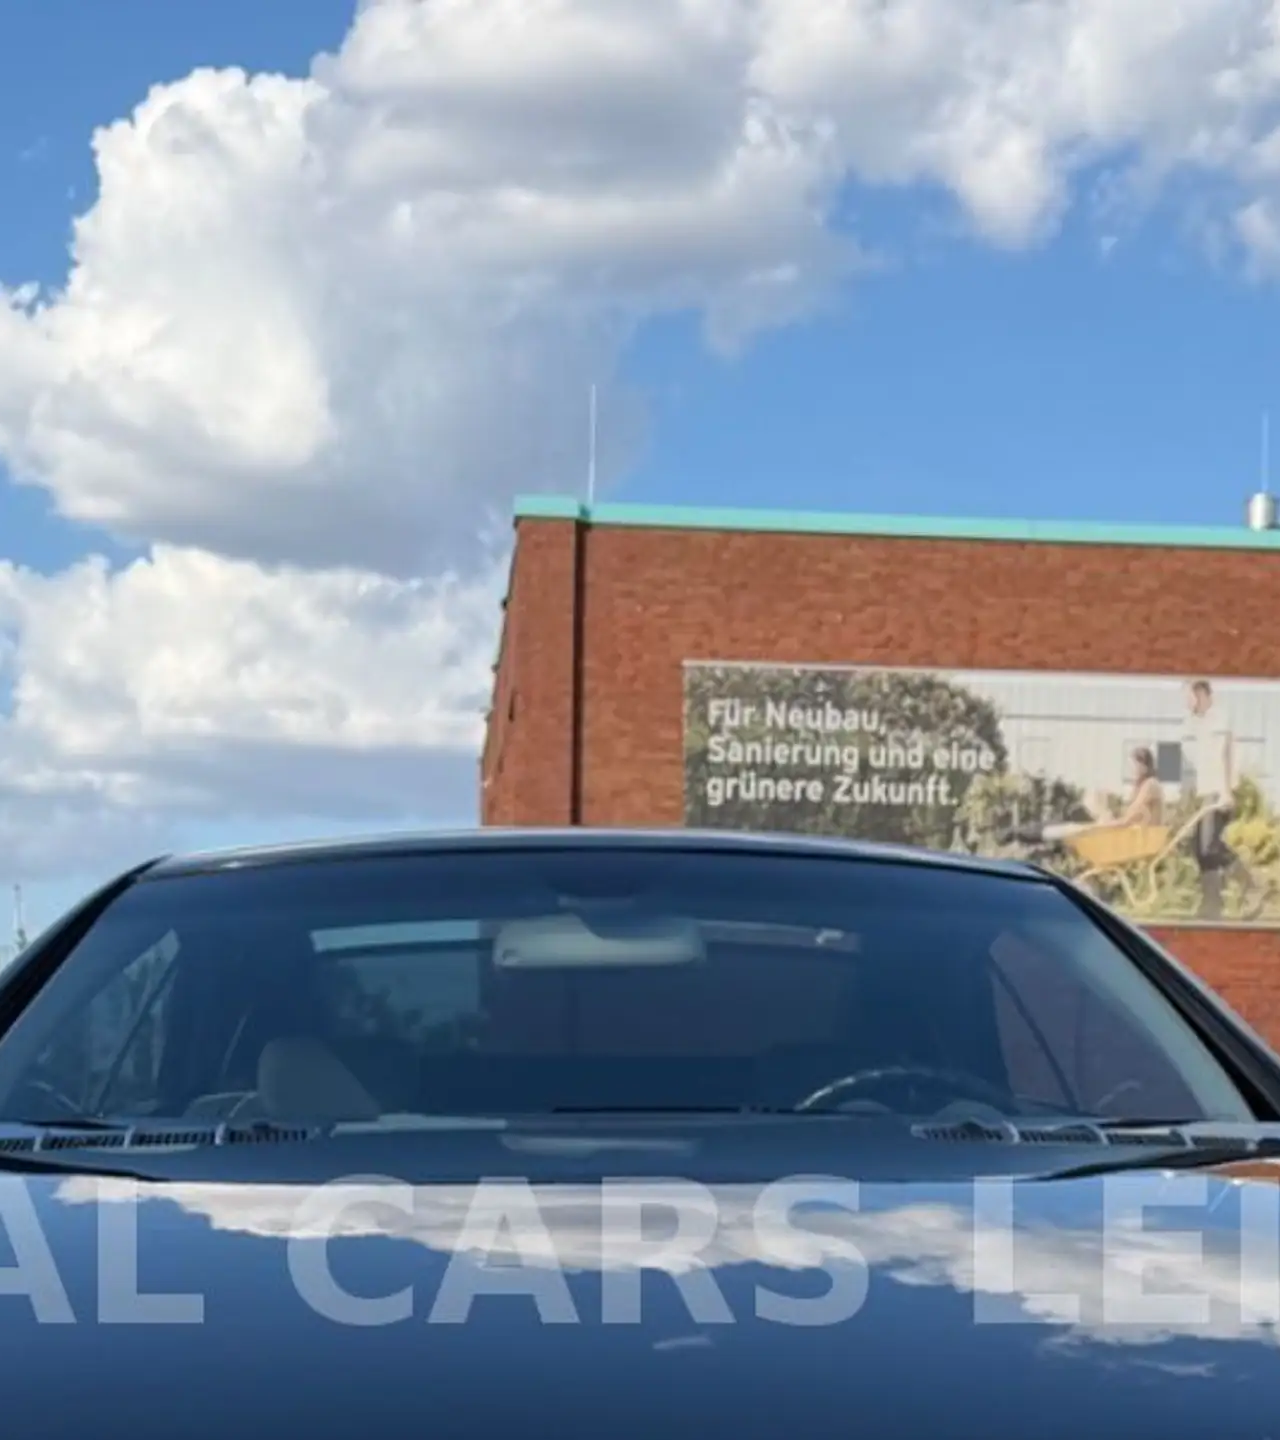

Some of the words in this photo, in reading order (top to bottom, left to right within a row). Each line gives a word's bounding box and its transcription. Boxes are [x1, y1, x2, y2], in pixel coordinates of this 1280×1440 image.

[707, 698, 756, 727] Für
[765, 702, 888, 734] Neubau,
[707, 735, 859, 773] Sanierung
[869, 741, 924, 769] und
[932, 743, 996, 770] eine
[706, 771, 824, 806] grünere
[832, 775, 959, 806] Zukunft.
